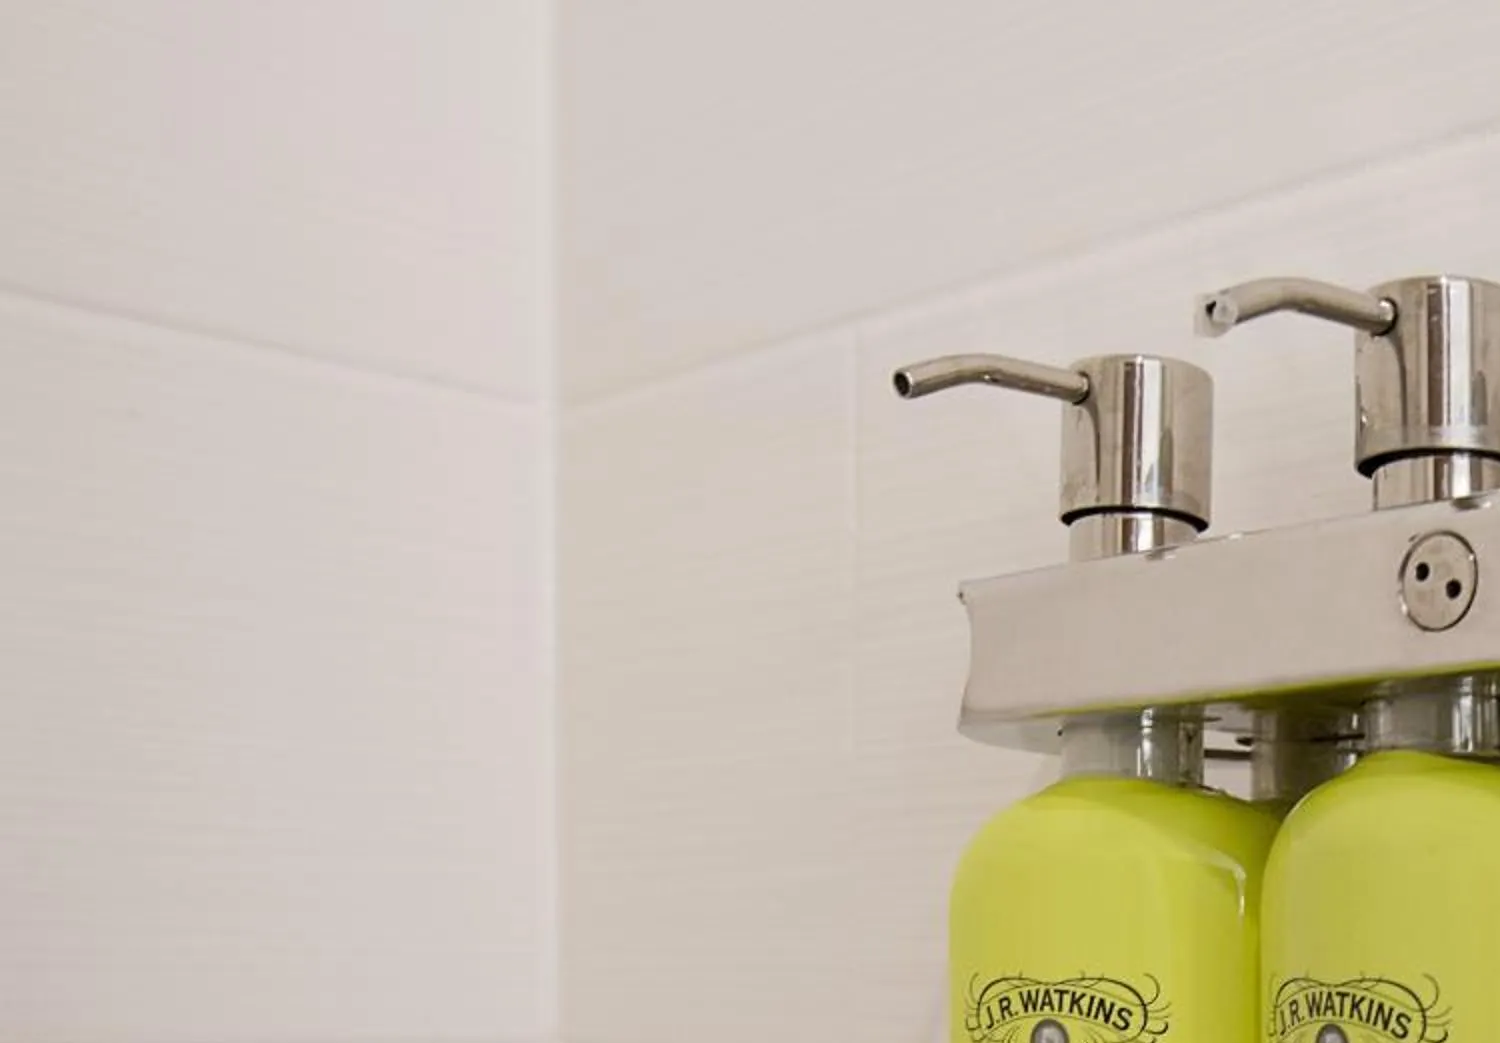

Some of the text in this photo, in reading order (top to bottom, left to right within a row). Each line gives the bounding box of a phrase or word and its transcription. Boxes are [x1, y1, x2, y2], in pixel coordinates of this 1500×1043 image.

[986, 989, 1133, 1032] J.R. WATKINS
[1278, 990, 1412, 1040] J.R. WATKINS
